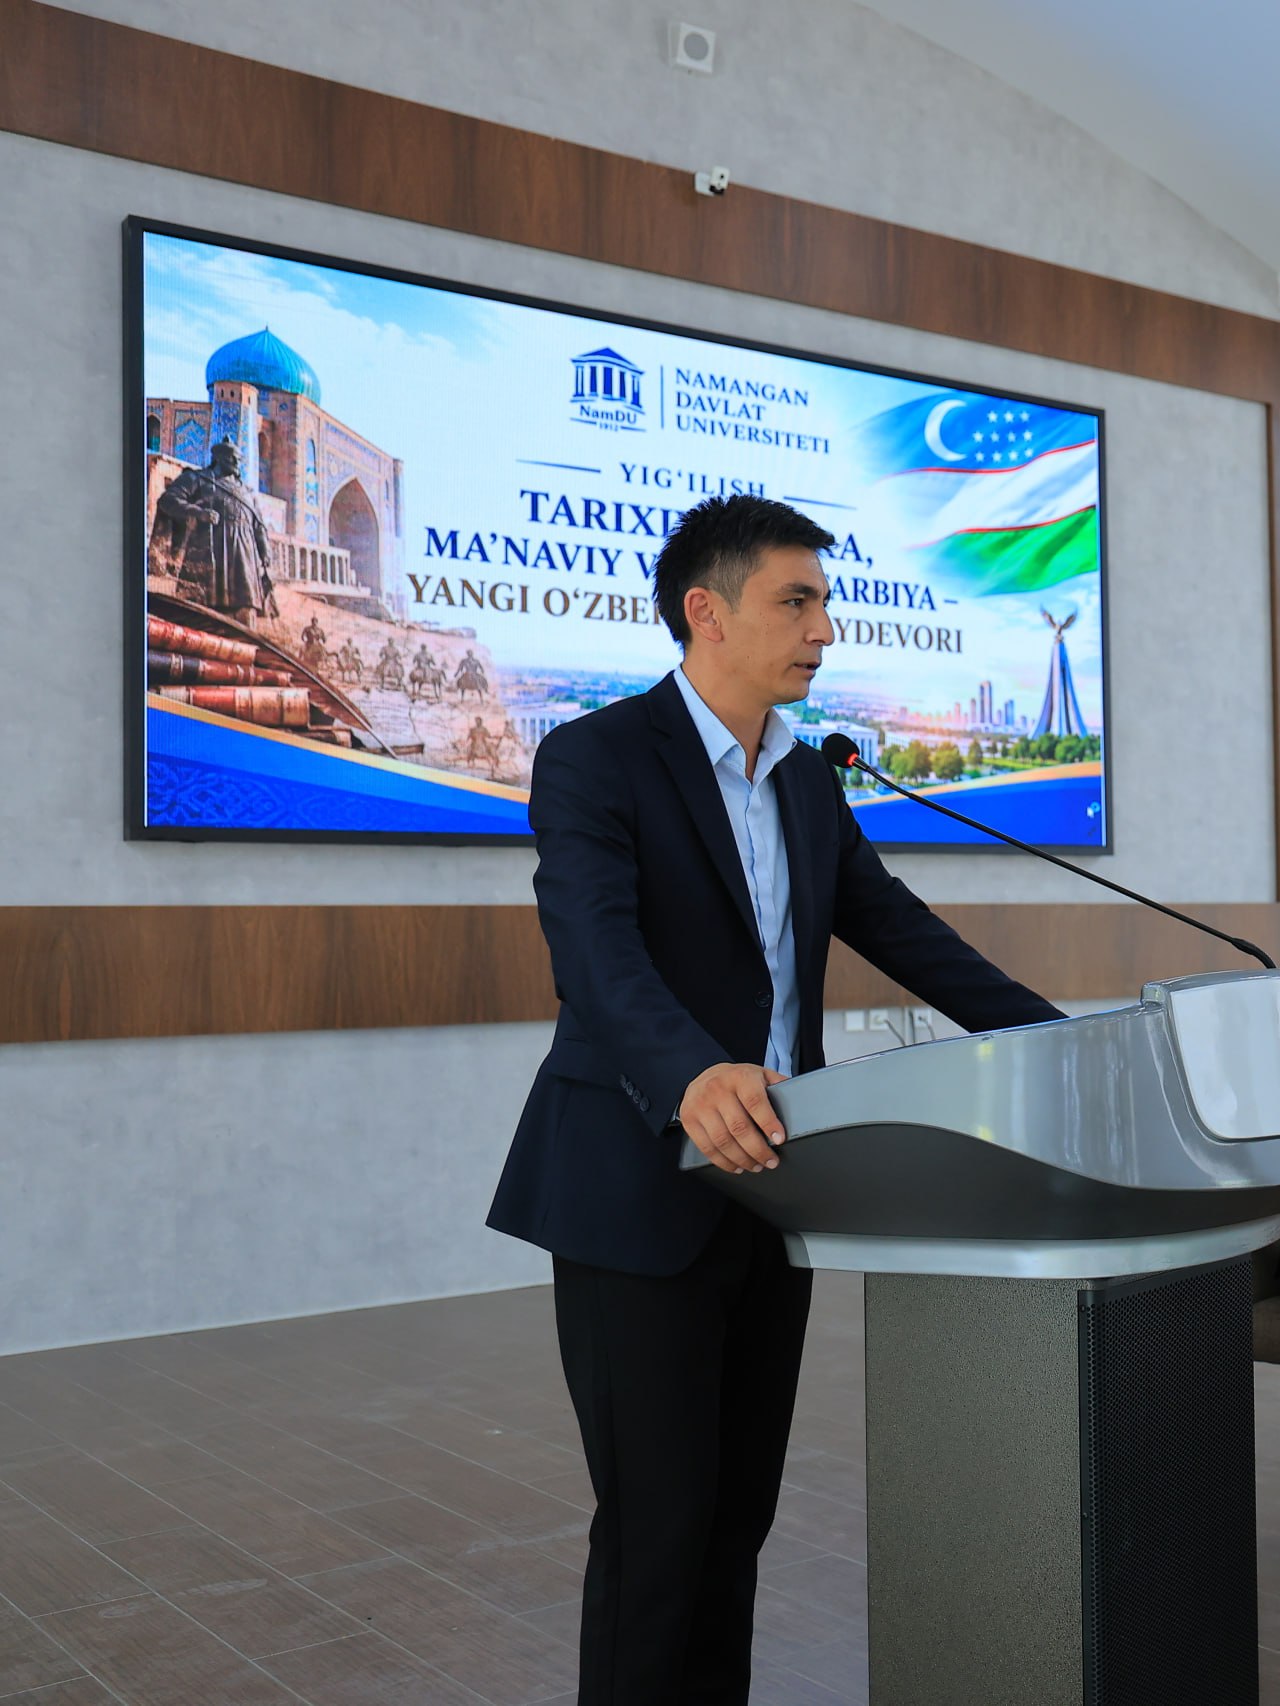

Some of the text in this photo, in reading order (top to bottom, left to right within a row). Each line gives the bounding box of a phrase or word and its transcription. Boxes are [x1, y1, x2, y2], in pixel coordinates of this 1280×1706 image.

[676, 368, 809, 407] NAMANGAN
[676, 392, 766, 421] DAVLAT
[579, 405, 638, 424] NamDU
[676, 415, 830, 454] UNIVERSITETI
[520, 490, 678, 537] TARIXI
[828, 574, 937, 611] ARBIYA
[406, 573, 530, 614] YANGI
[833, 617, 963, 653] YDEVORI
